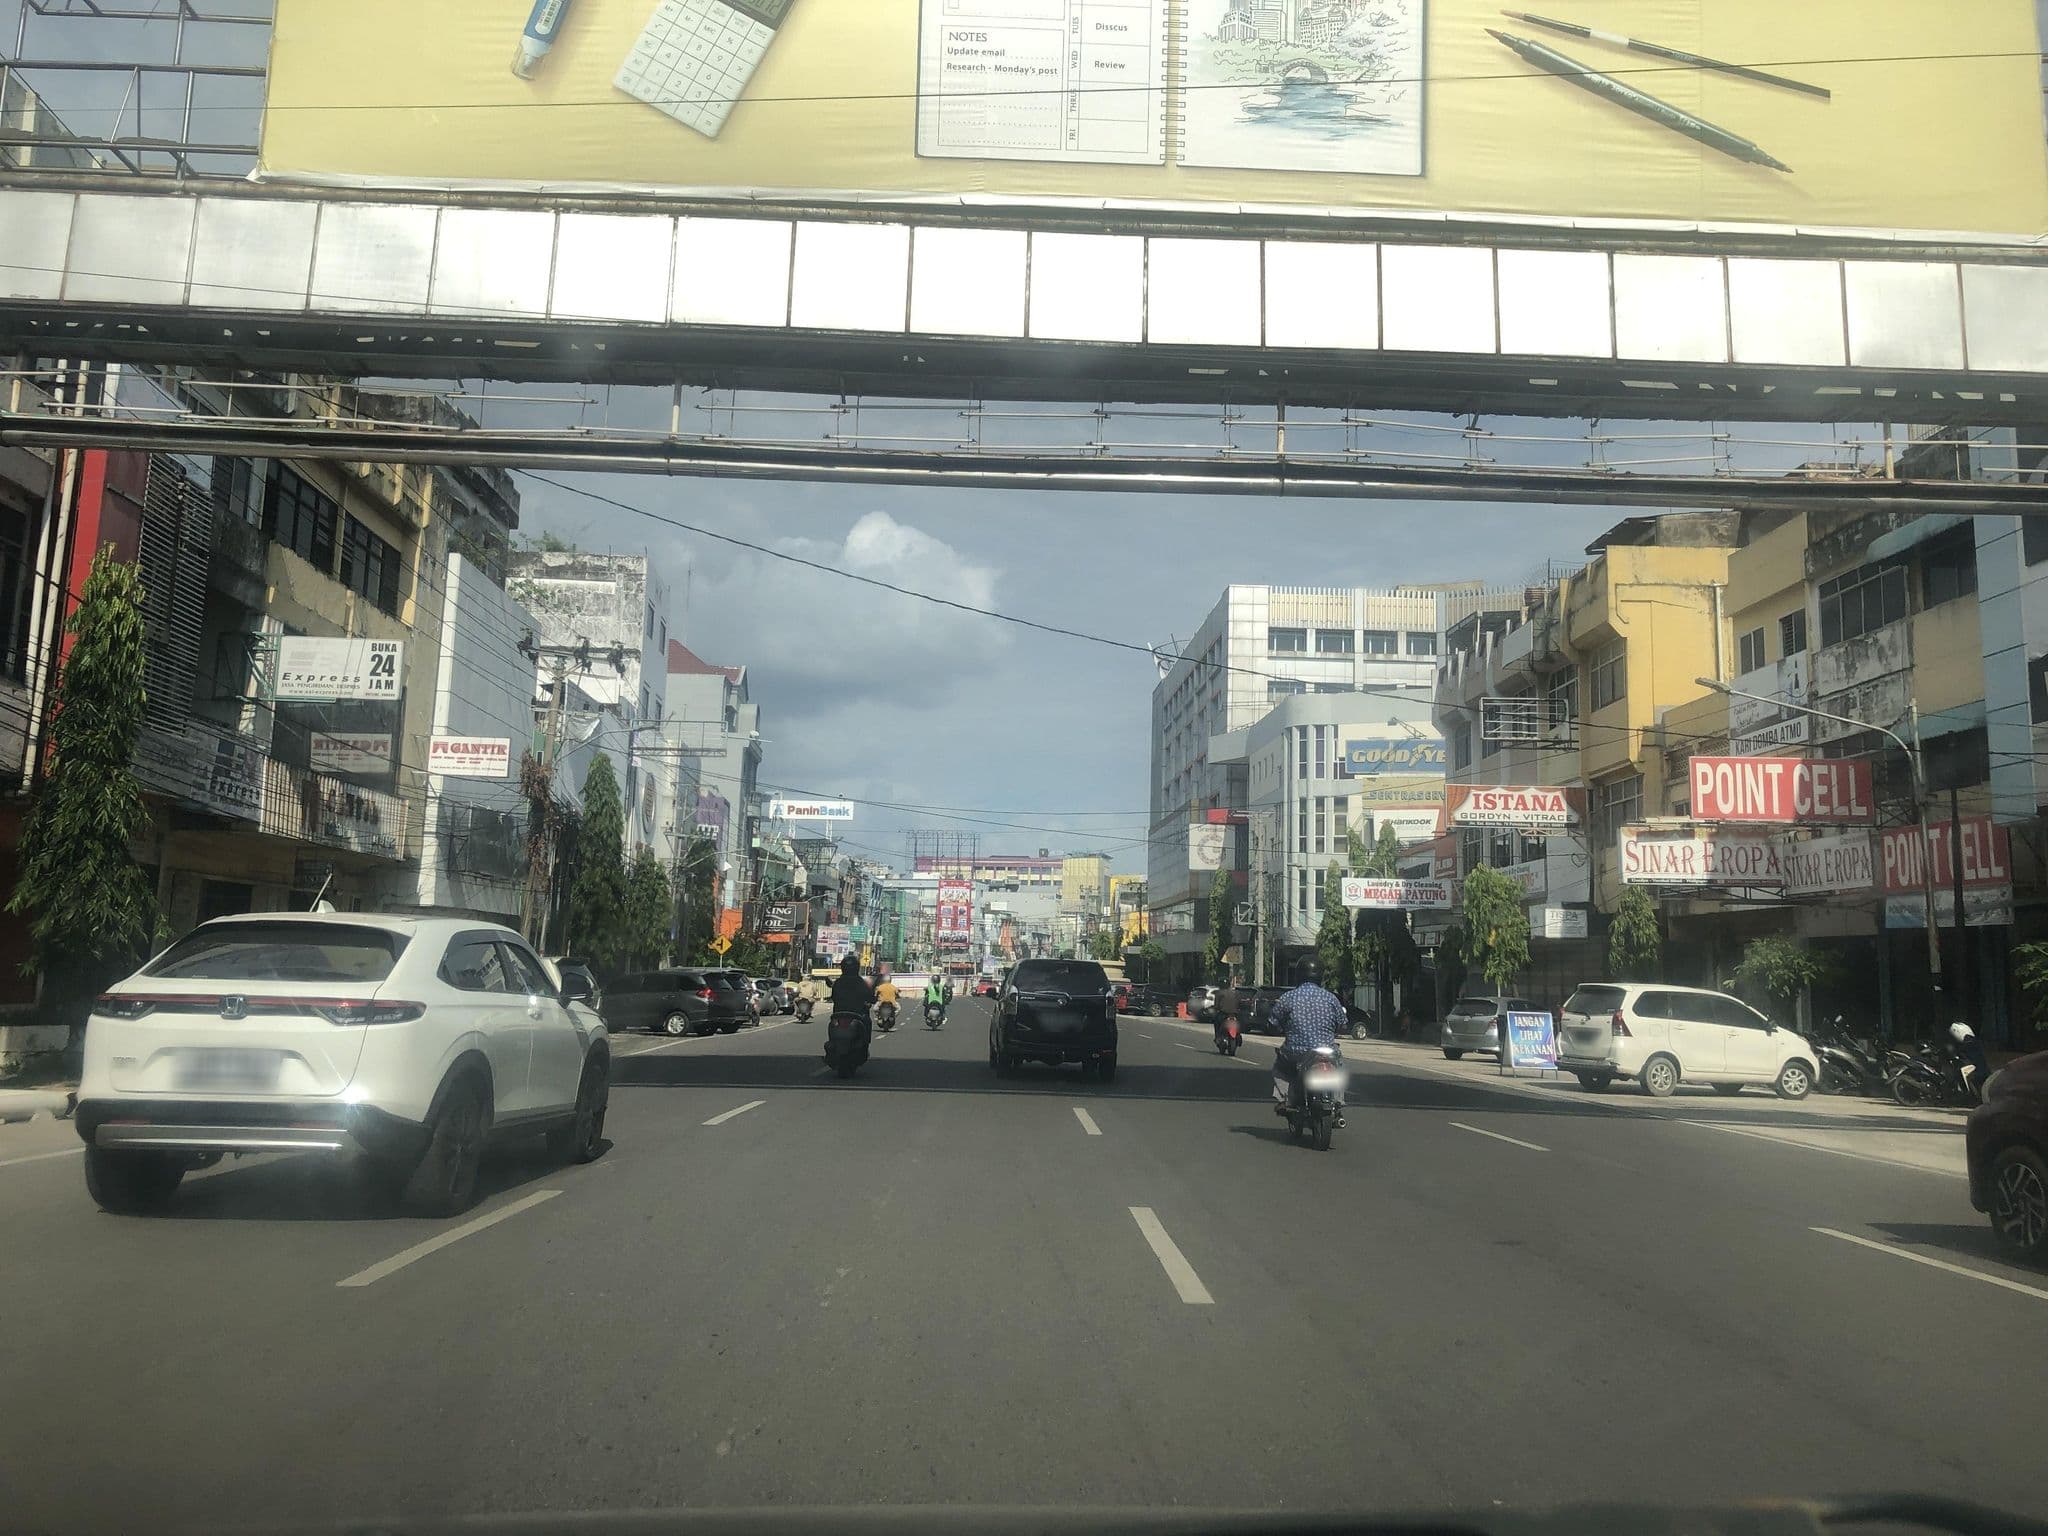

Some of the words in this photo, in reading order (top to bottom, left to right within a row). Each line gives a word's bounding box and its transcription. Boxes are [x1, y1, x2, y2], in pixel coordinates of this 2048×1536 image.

[1071, 16, 1080, 35] TUES
[1095, 22, 1128, 32] Disscus
[948, 31, 988, 42] NOTES
[947, 47, 979, 56] Update
[981, 49, 1005, 57] email
[1070, 50, 1079, 70] WED
[1094, 60, 1126, 70] Review
[946, 62, 986, 71] Research
[994, 65, 1036, 76] Monday's
[1068, 128, 1077, 141] FRI
[371, 642, 397, 653] BUKA
[369, 653, 395, 677] 24
[282, 672, 361, 683] Express
[368, 679, 394, 690] JAM
[1752, 727, 1779, 751] DOMBA
[1780, 721, 1802, 742] ATMO
[1695, 762, 1784, 815] POINT
[1792, 763, 1868, 817] CELL
[1472, 793, 1566, 812] ISTANA
[786, 804, 850, 817] PaninBank
[1460, 812, 1511, 820] GORDYN
[1523, 814, 1573, 822] VITRACE
[1625, 840, 1695, 875] SINAR
[1702, 841, 1781, 875] EROPA
[1883, 828, 1941, 888] POINT
[1825, 845, 1872, 884] EROPA
[1402, 881, 1413, 889] Dry
[1364, 888, 1402, 899] MEGAH
[1406, 889, 1446, 900] PAYUNG
